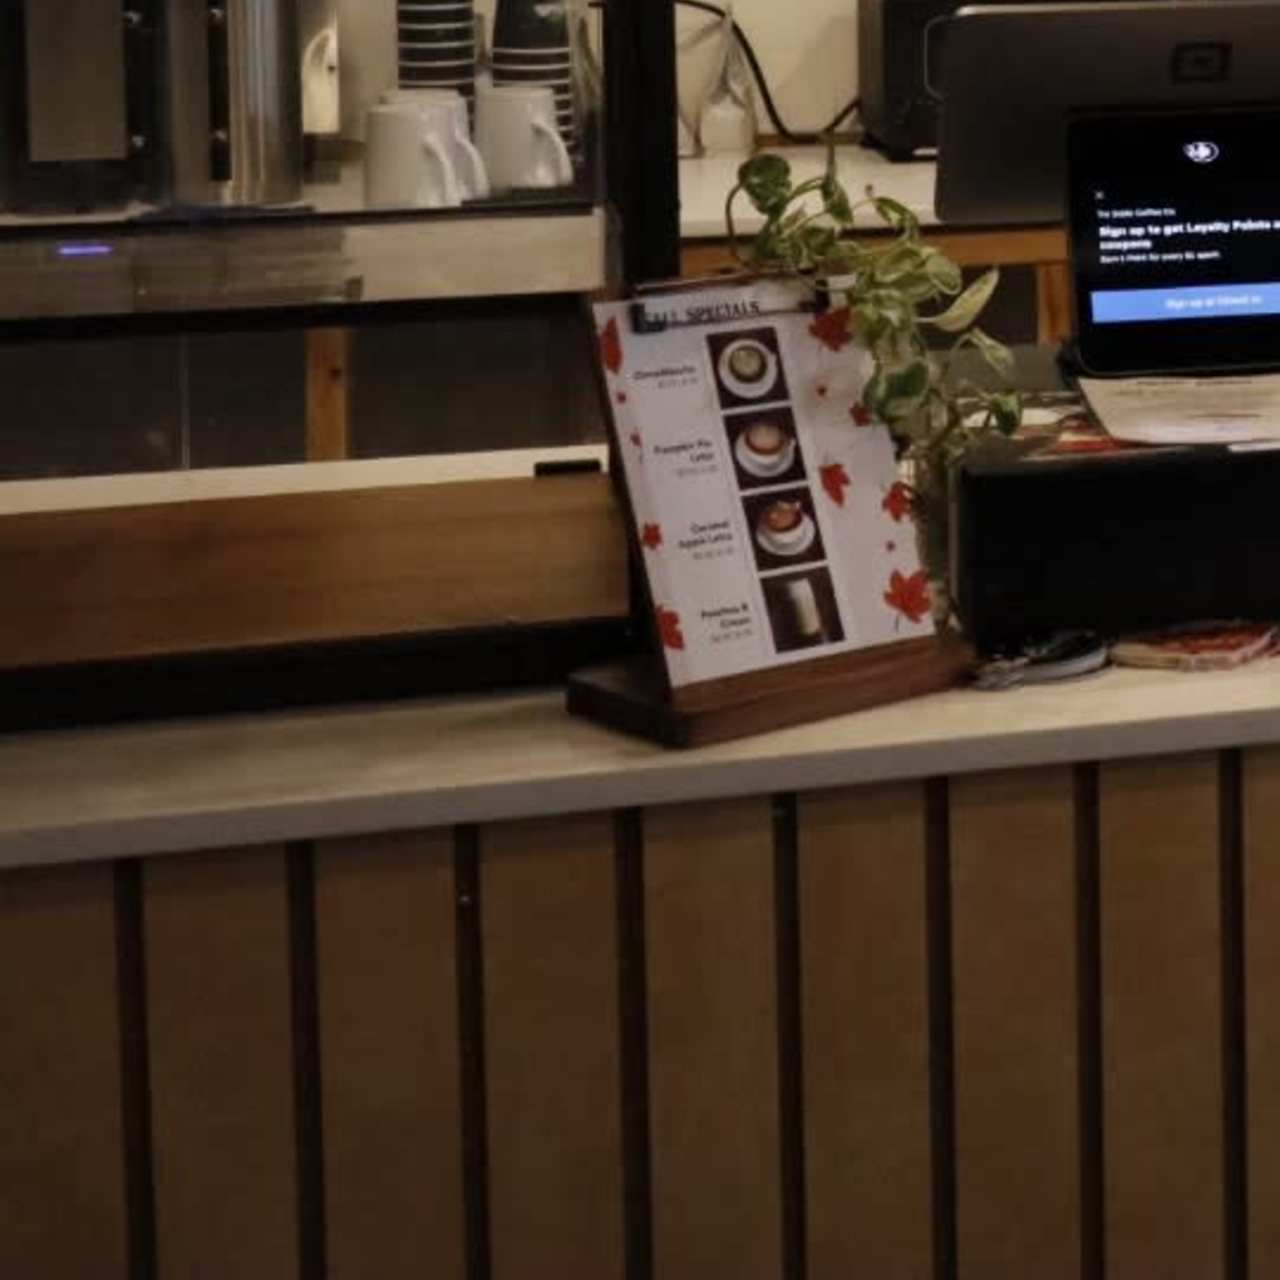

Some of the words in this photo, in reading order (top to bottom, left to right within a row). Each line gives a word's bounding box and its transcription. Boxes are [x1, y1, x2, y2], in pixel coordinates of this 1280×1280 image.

[1098, 225, 1127, 239] Sign
[1128, 226, 1146, 238] up
[1147, 224, 1162, 236] to
[1162, 223, 1185, 237] get
[1186, 221, 1231, 235] Loyalty
[1231, 218, 1272, 232] Points
[685, 300, 760, 322] SPECIALS
